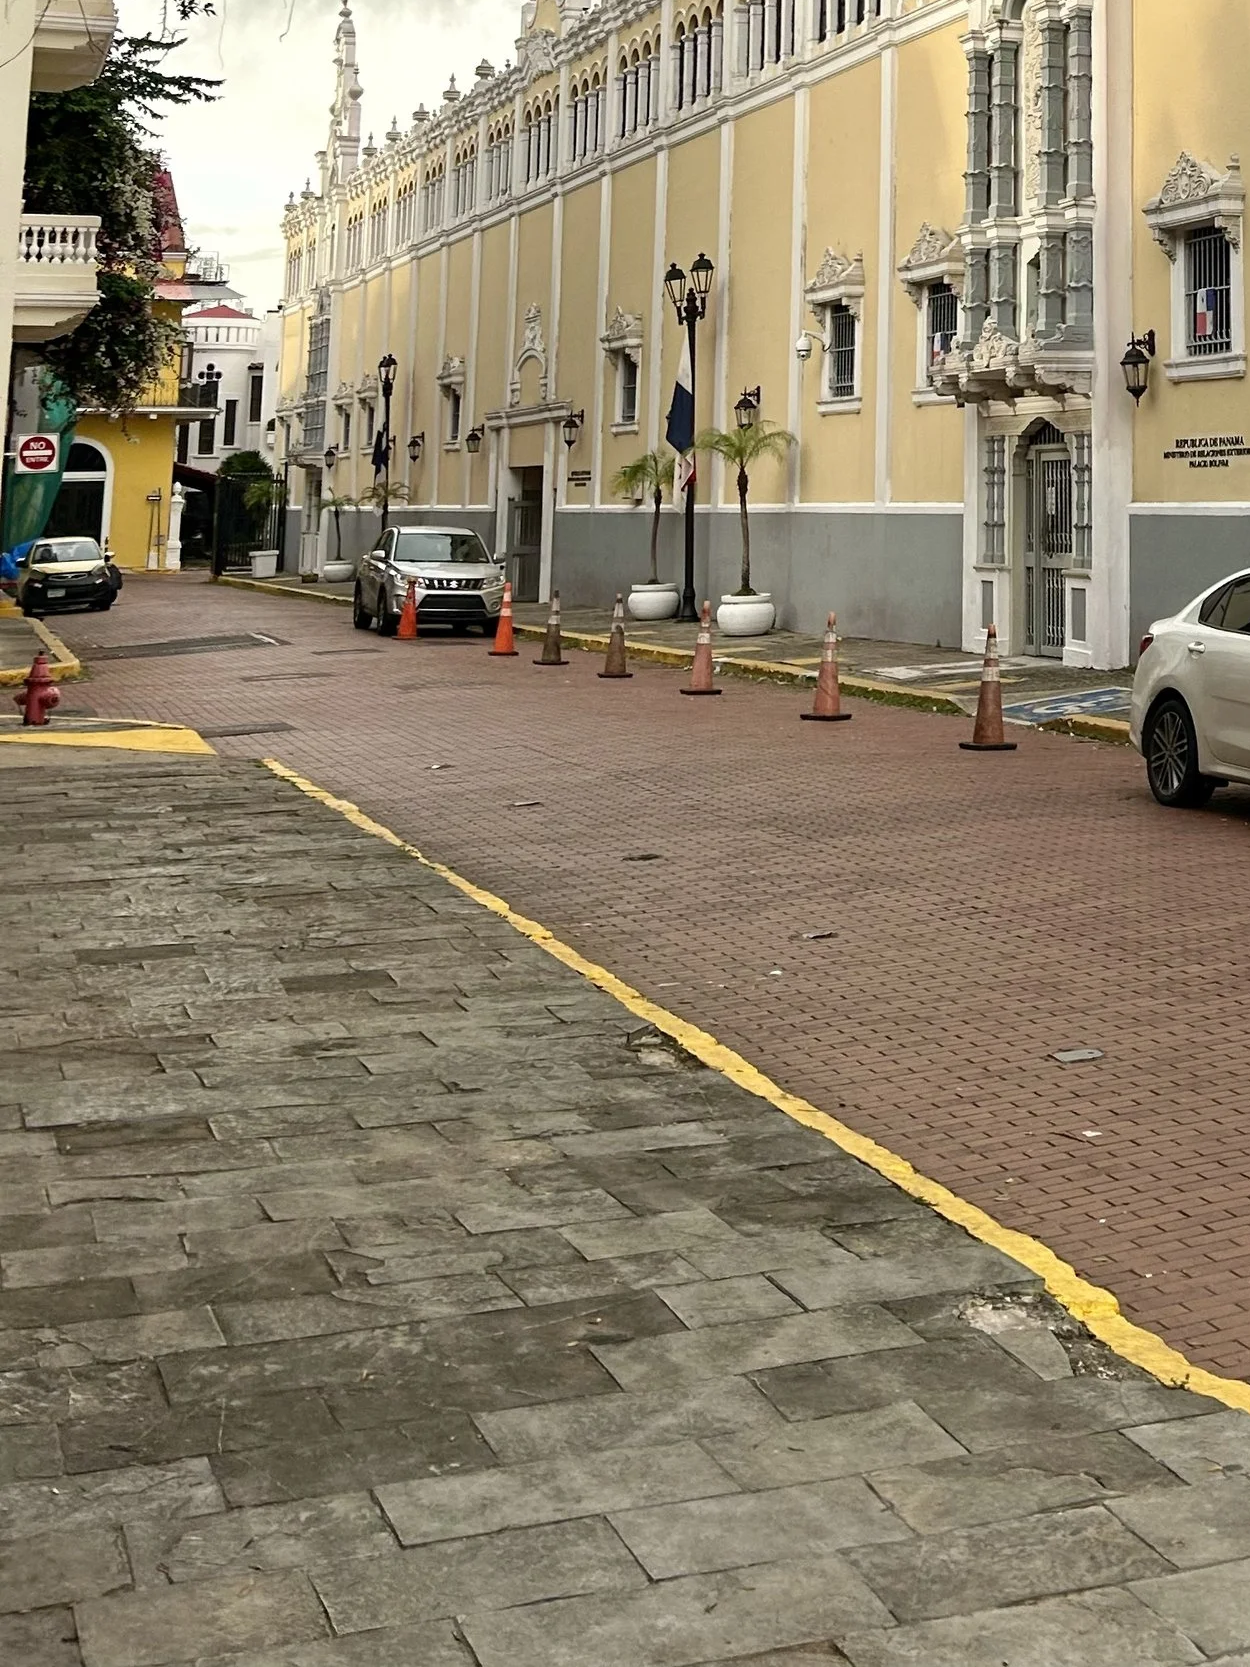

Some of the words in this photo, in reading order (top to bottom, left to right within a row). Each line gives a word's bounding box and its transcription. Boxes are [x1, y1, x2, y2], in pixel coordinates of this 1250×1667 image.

[30, 441, 46, 449] NO
[1175, 438, 1208, 448] REPUBLICA
[1209, 437, 1218, 447] DE
[1219, 436, 1244, 447] PANAMA
